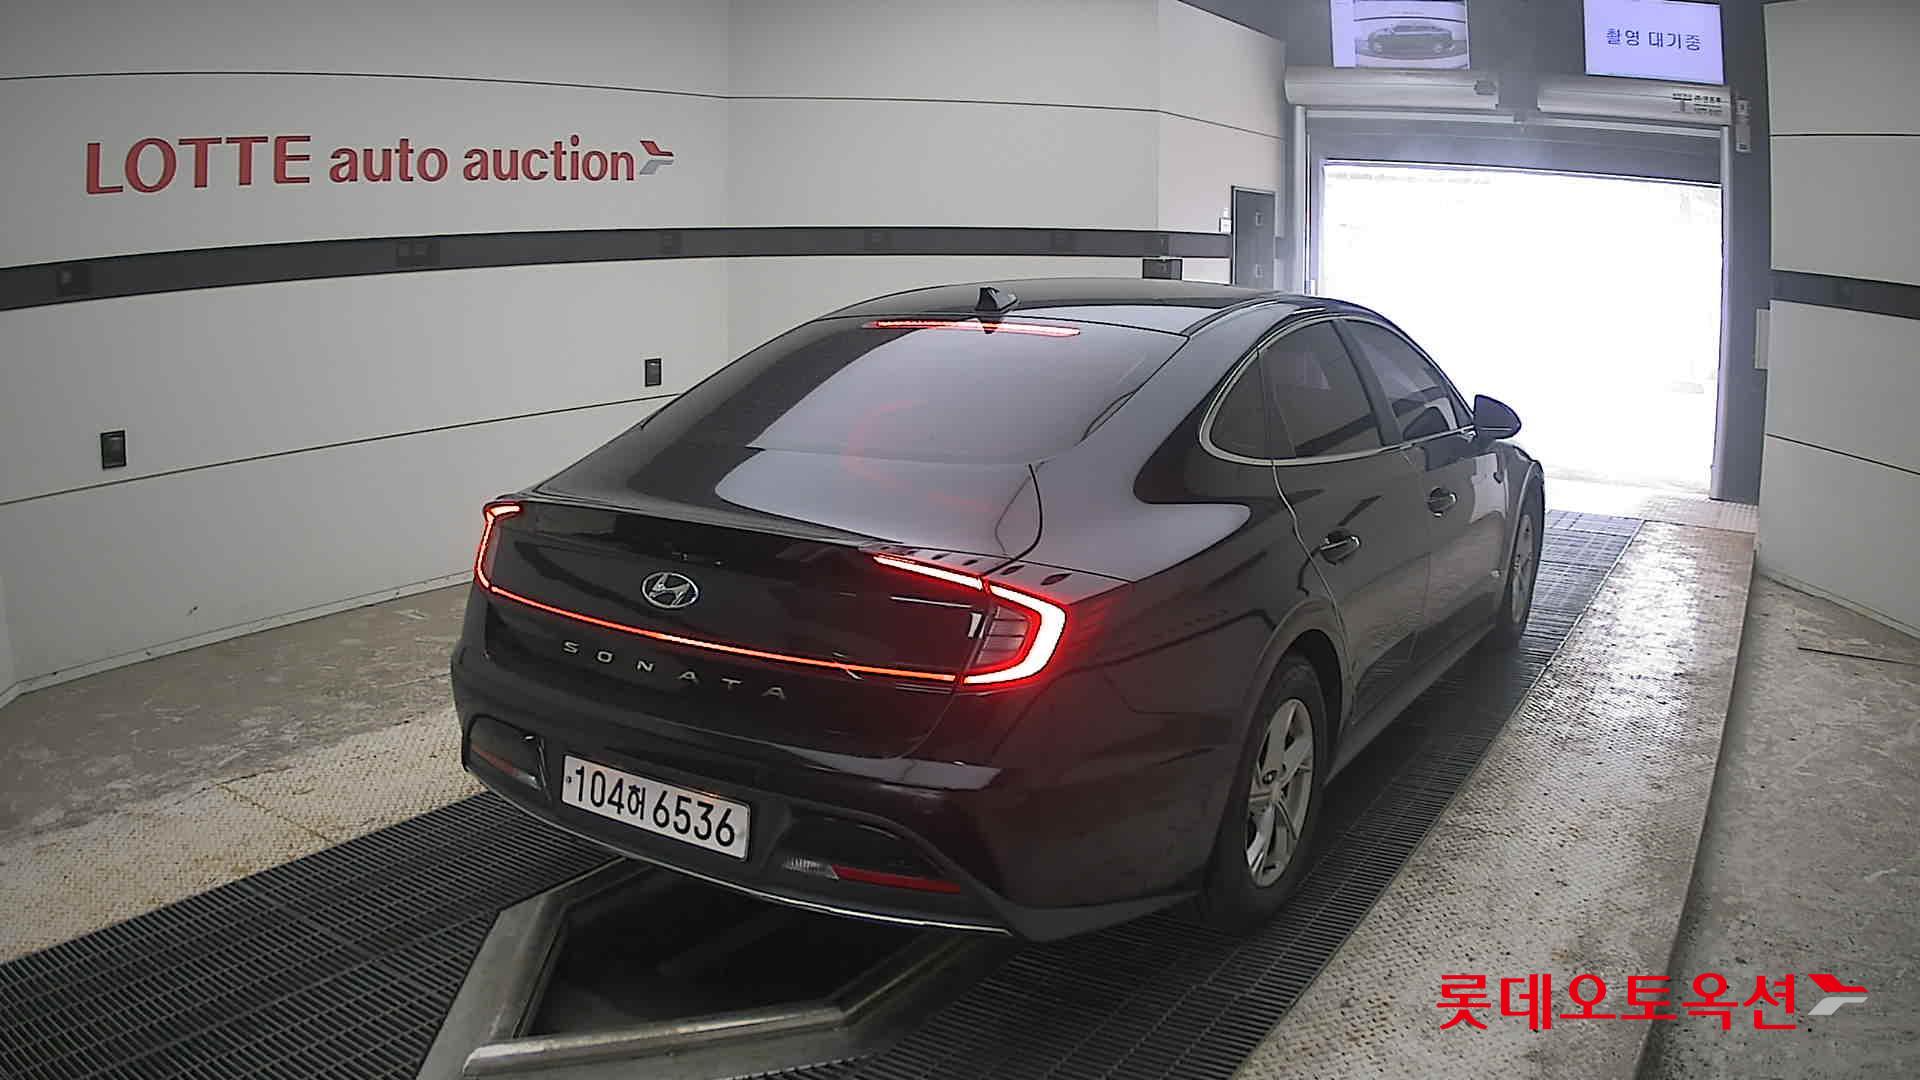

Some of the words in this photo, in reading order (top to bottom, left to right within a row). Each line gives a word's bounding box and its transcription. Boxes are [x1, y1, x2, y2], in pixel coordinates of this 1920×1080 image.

[1648, 31, 1701, 51] 대기중
[86, 135, 311, 194] LOTTE
[329, 138, 448, 183] auto
[463, 134, 635, 182] auction
[563, 640, 786, 700] SONATA
